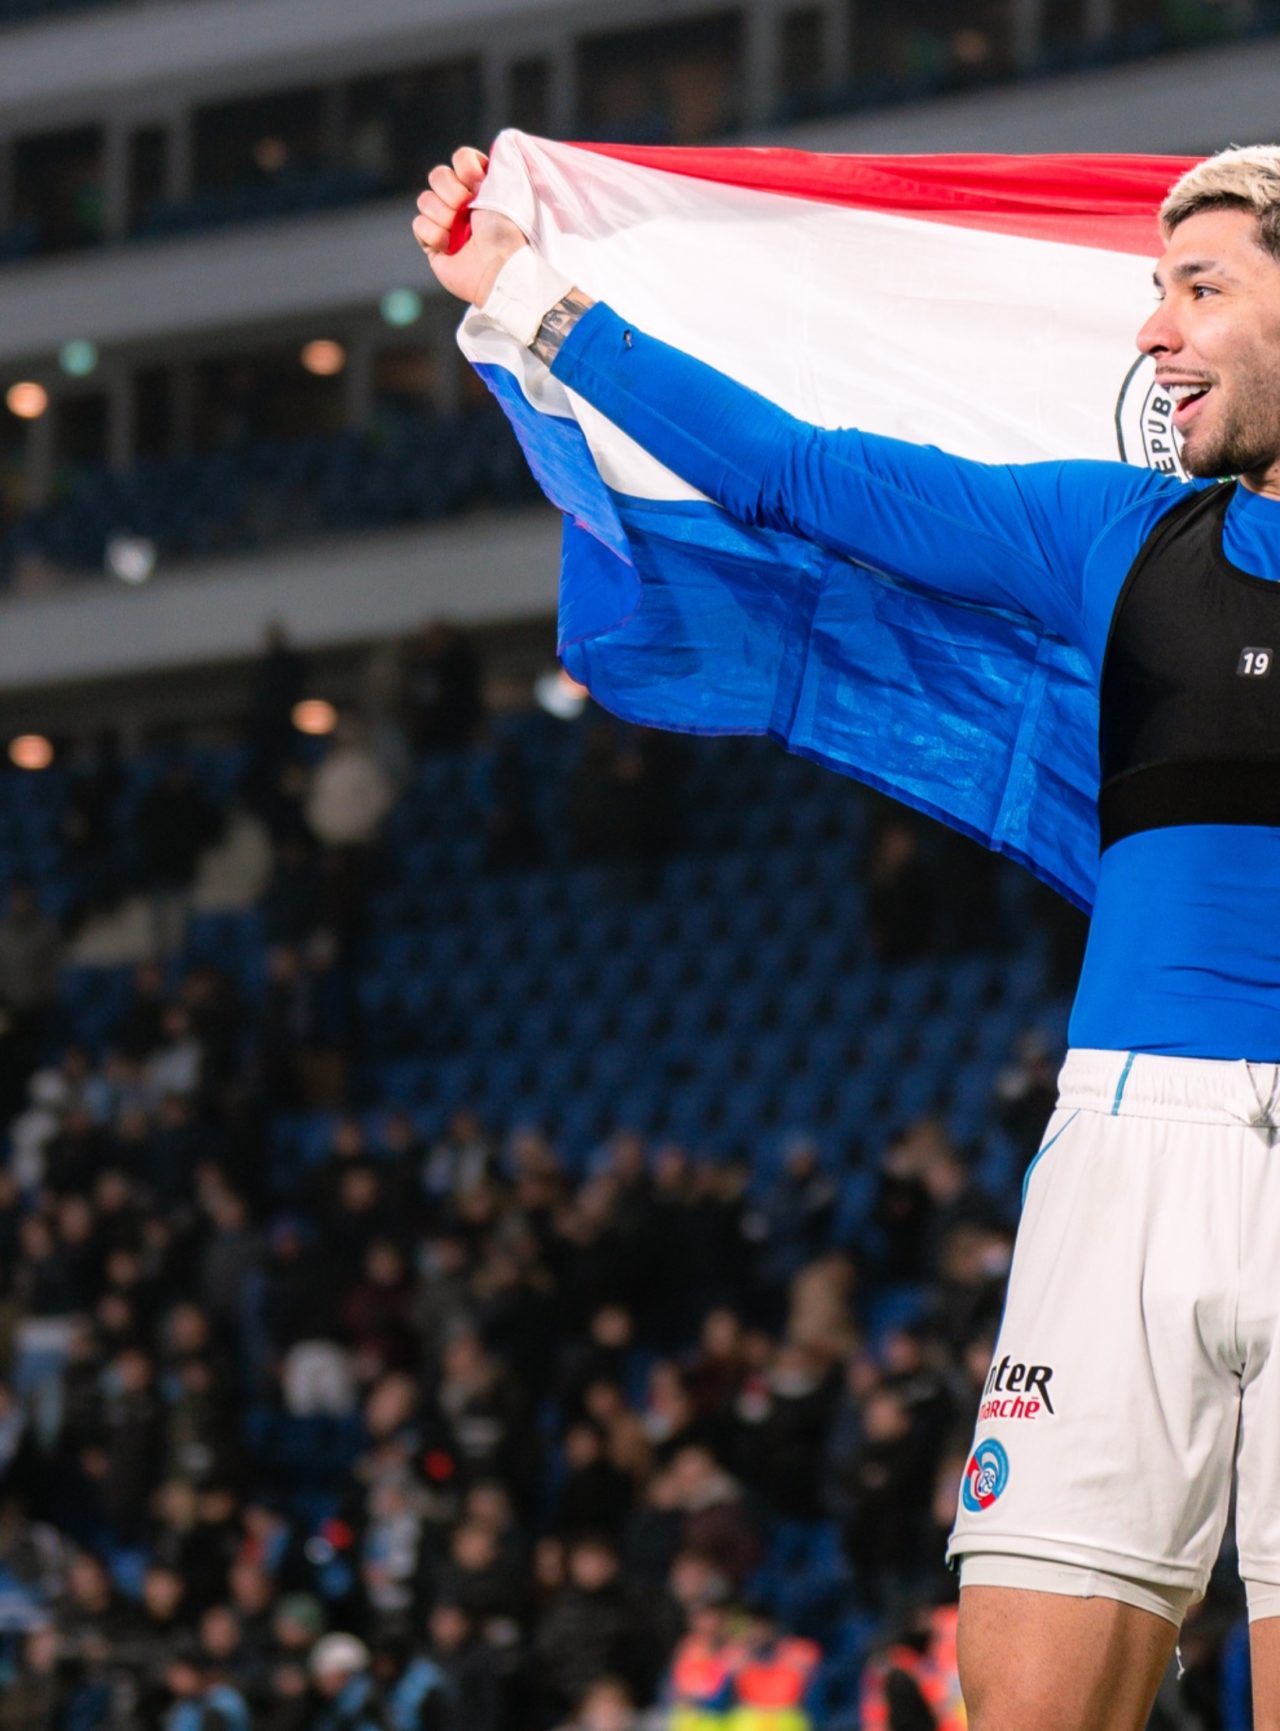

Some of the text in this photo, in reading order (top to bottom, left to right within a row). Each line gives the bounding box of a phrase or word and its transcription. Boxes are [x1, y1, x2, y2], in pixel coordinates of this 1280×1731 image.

[1147, 396, 1177, 475] EPUB
[1243, 652, 1269, 675] 19
[984, 1354, 1055, 1415] nteR
